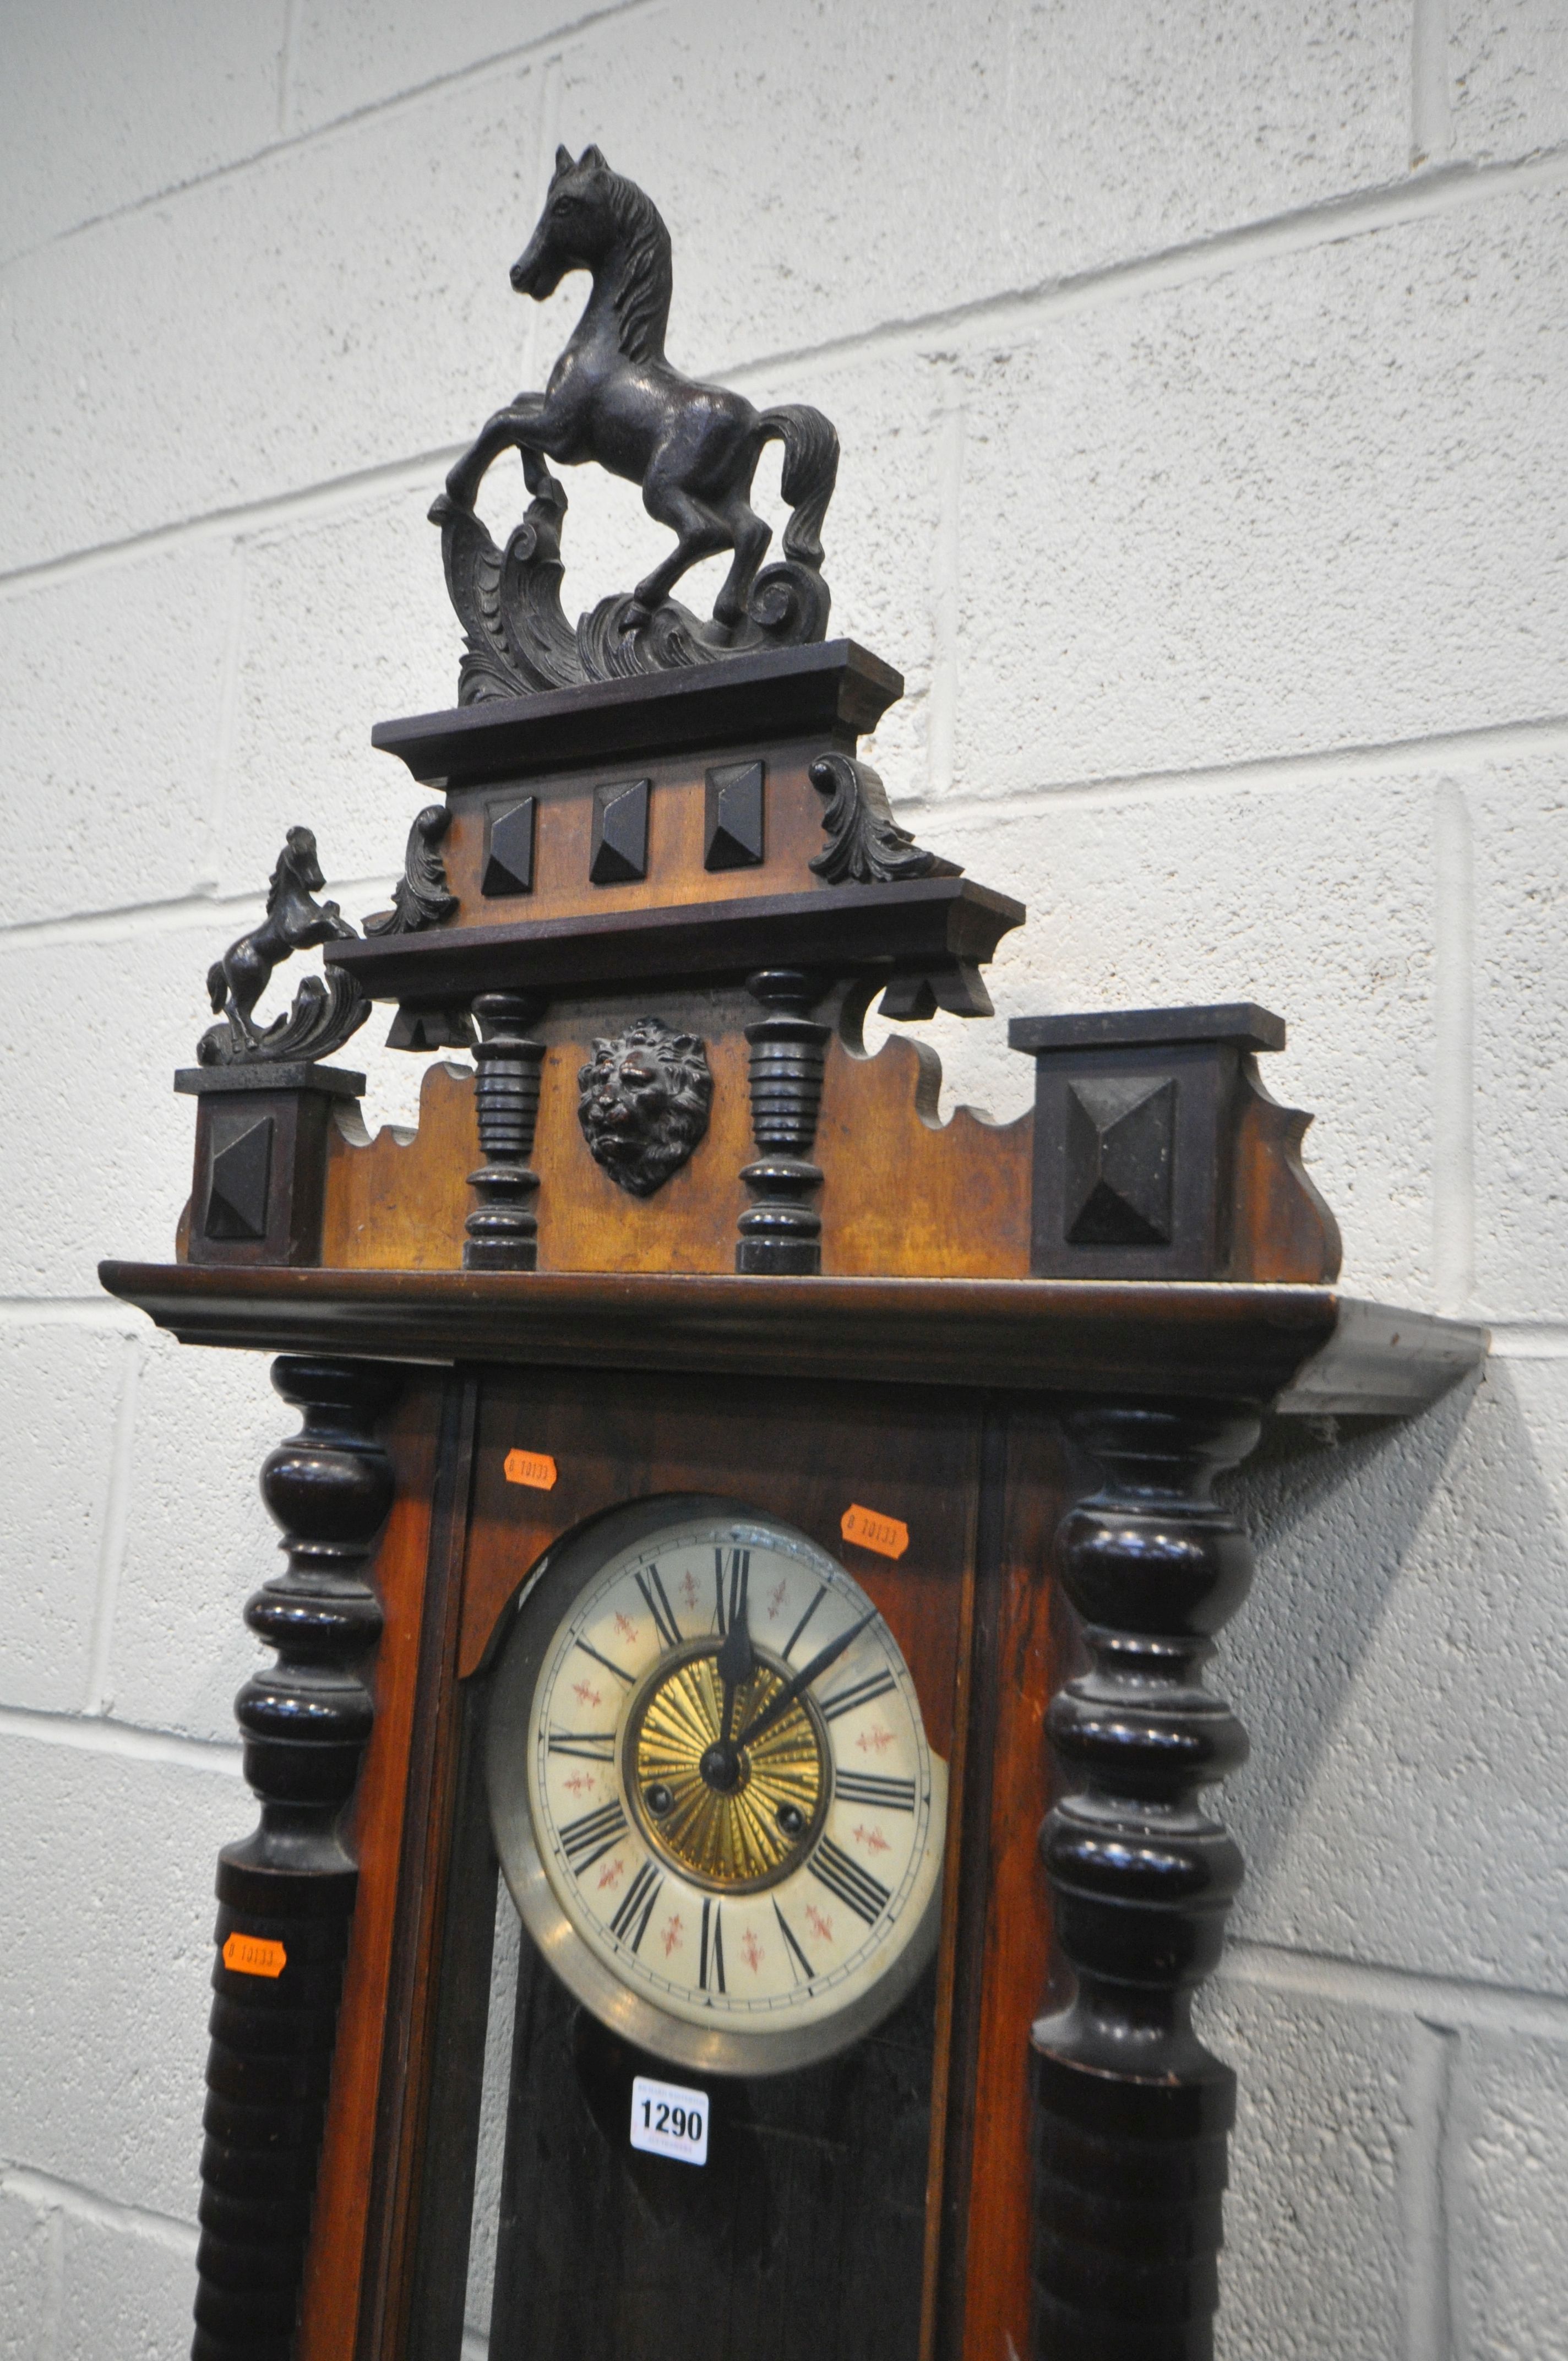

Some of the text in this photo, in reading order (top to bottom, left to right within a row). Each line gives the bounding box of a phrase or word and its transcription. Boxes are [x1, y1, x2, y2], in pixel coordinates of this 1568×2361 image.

[635, 1562, 684, 1652] XI
[710, 1548, 750, 1636] XII
[548, 1721, 617, 1765] IX
[835, 1768, 916, 1817] III
[557, 1798, 630, 1879] VIII
[807, 1834, 894, 1929] IIII
[609, 1854, 666, 1955] VII
[697, 1897, 729, 1994] VI
[641, 2098, 703, 2141] 1290
